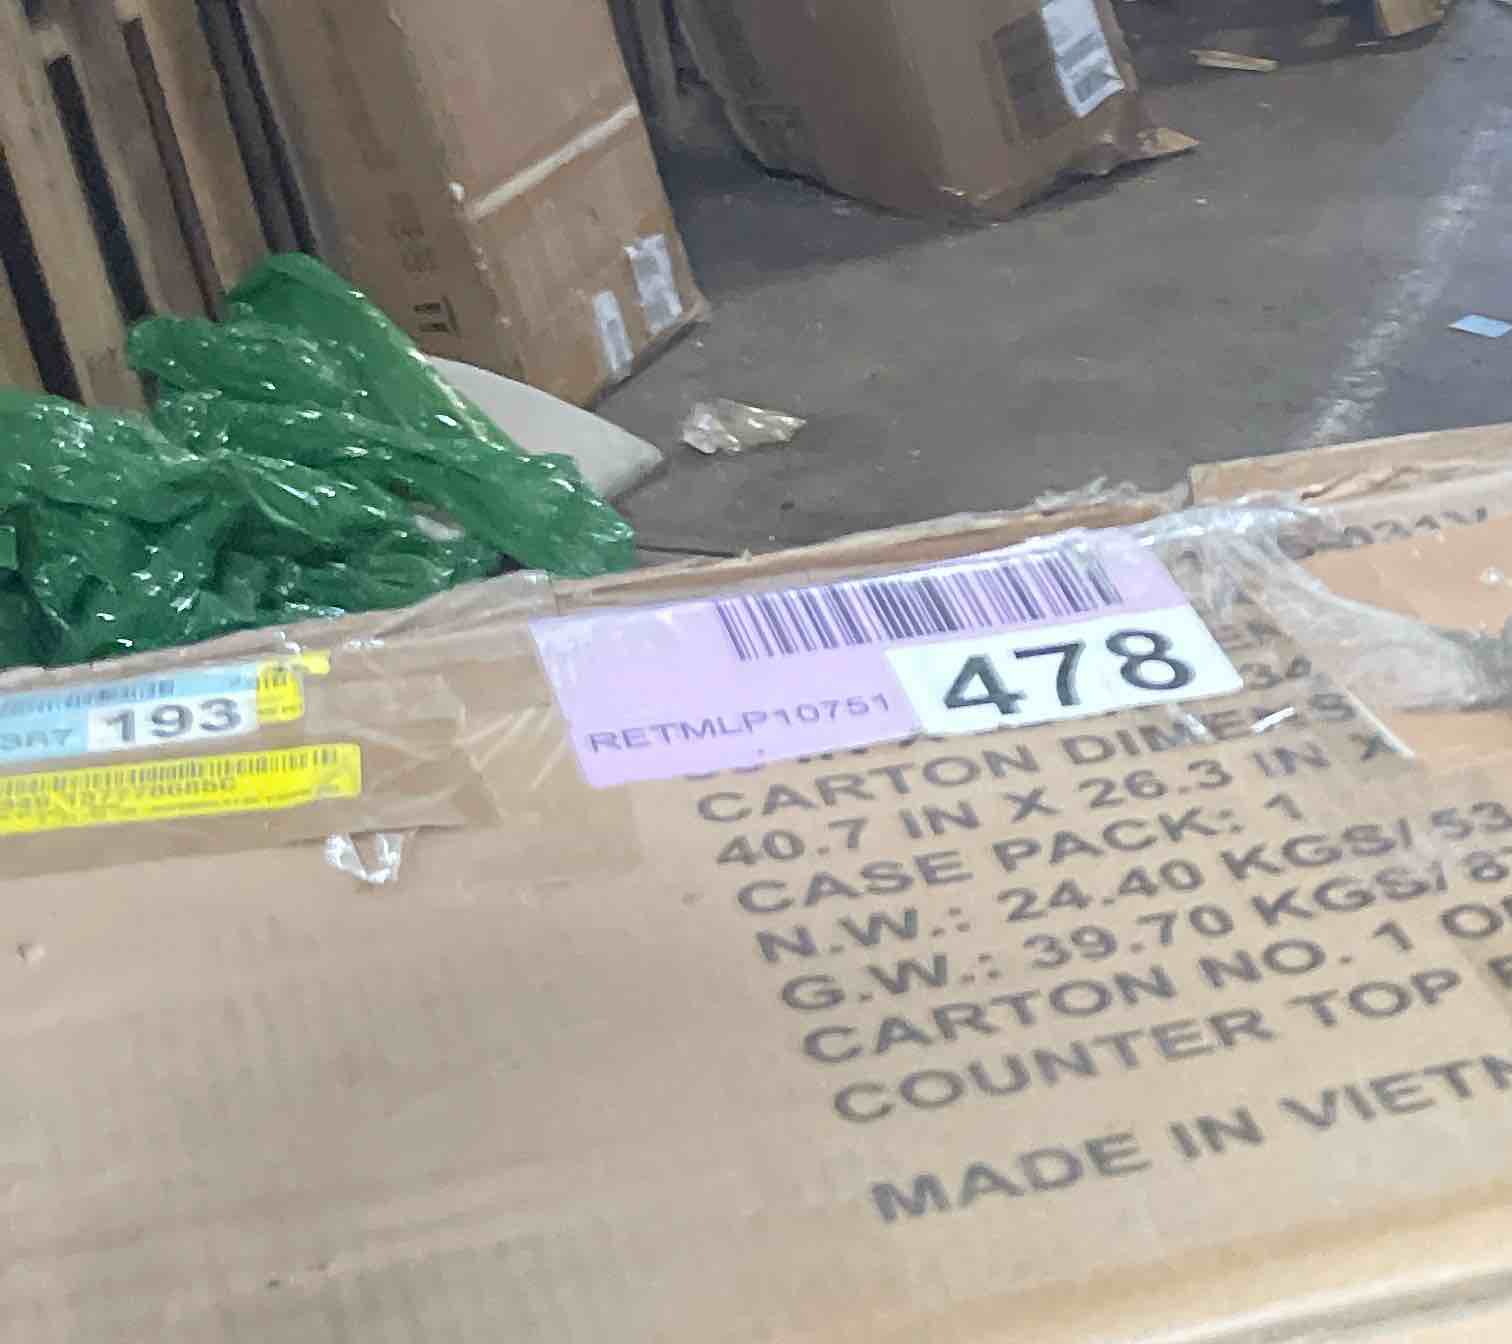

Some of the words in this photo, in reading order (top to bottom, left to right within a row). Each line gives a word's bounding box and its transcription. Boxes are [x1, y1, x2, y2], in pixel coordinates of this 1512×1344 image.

[940, 628, 1195, 717] 478
[103, 697, 243, 743] 193
[587, 692, 890, 755] RETMLP10751
[697, 742, 1041, 823] CARTON
[715, 816, 870, 867] 40.7
[897, 799, 982, 840] IN
[1006, 786, 1060, 823] X
[1077, 757, 1235, 810] 26.3
[736, 849, 974, 915] CASE
[992, 804, 1244, 872] PACK:
[1265, 792, 1304, 823] 1
[997, 857, 1207, 924] 24.40
[1022, 902, 1236, 970] 39.70
[801, 962, 1180, 1067] CARTON
[1198, 935, 1357, 995] NO.
[1372, 919, 1414, 954] 1
[831, 1006, 1274, 1125] COUNTER
[1286, 965, 1463, 1029] TOP
[868, 1130, 1152, 1225] MADE
[1168, 1105, 1264, 1162] IN
